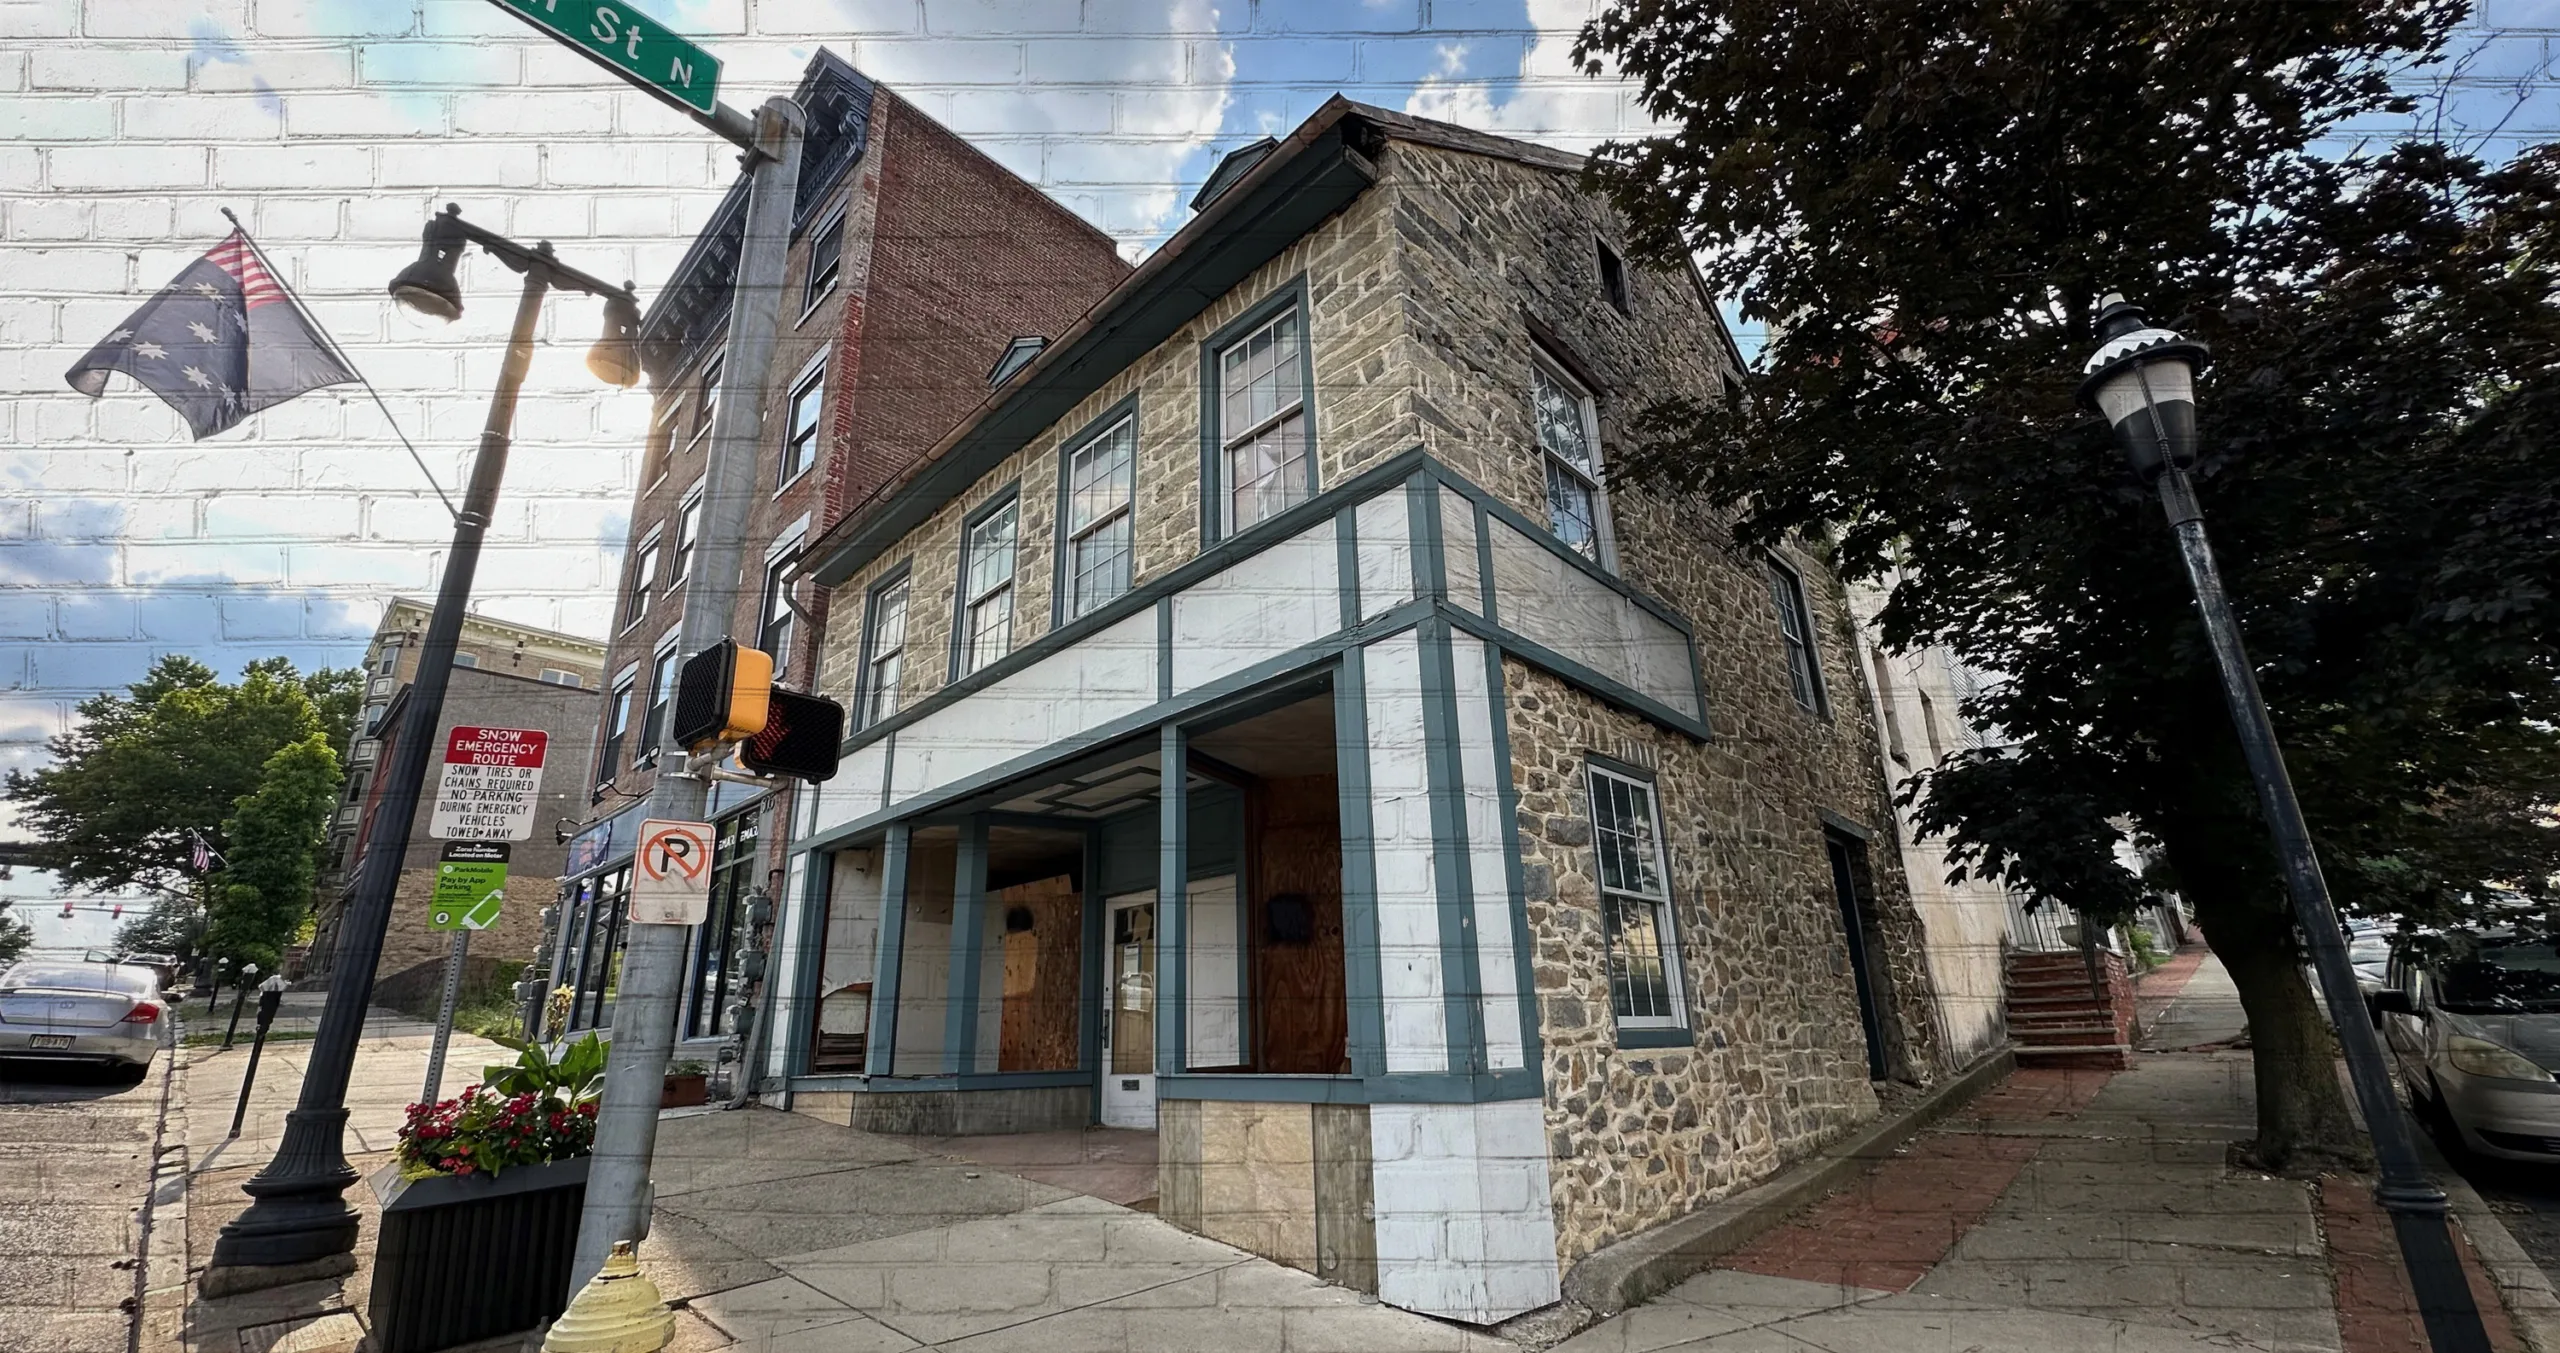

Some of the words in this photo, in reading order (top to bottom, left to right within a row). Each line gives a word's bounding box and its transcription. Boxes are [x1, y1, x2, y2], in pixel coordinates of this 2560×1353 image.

[591, 6, 643, 60] St
[670, 56, 693, 89] N
[478, 729, 522, 742] SNOW
[456, 740, 538, 755] EMERGENCY
[472, 753, 517, 766] ROUTE
[451, 765, 480, 776] SNOW
[486, 767, 513, 778] TIRES
[519, 768, 532, 779] OR
[444, 777, 481, 789] CHAINS
[487, 779, 534, 791] REQUIRED
[450, 790, 467, 801] NO
[473, 791, 523, 803] PARKING
[440, 802, 472, 813] DURING
[477, 803, 528, 815] EMERGENCY
[459, 815, 506, 827] VEHICLES
[446, 827, 479, 838] TOWED
[485, 828, 513, 839] AWAY
[440, 876, 457, 884] Pay
[458, 876, 468, 884] by
[440, 883, 471, 891] Parking
